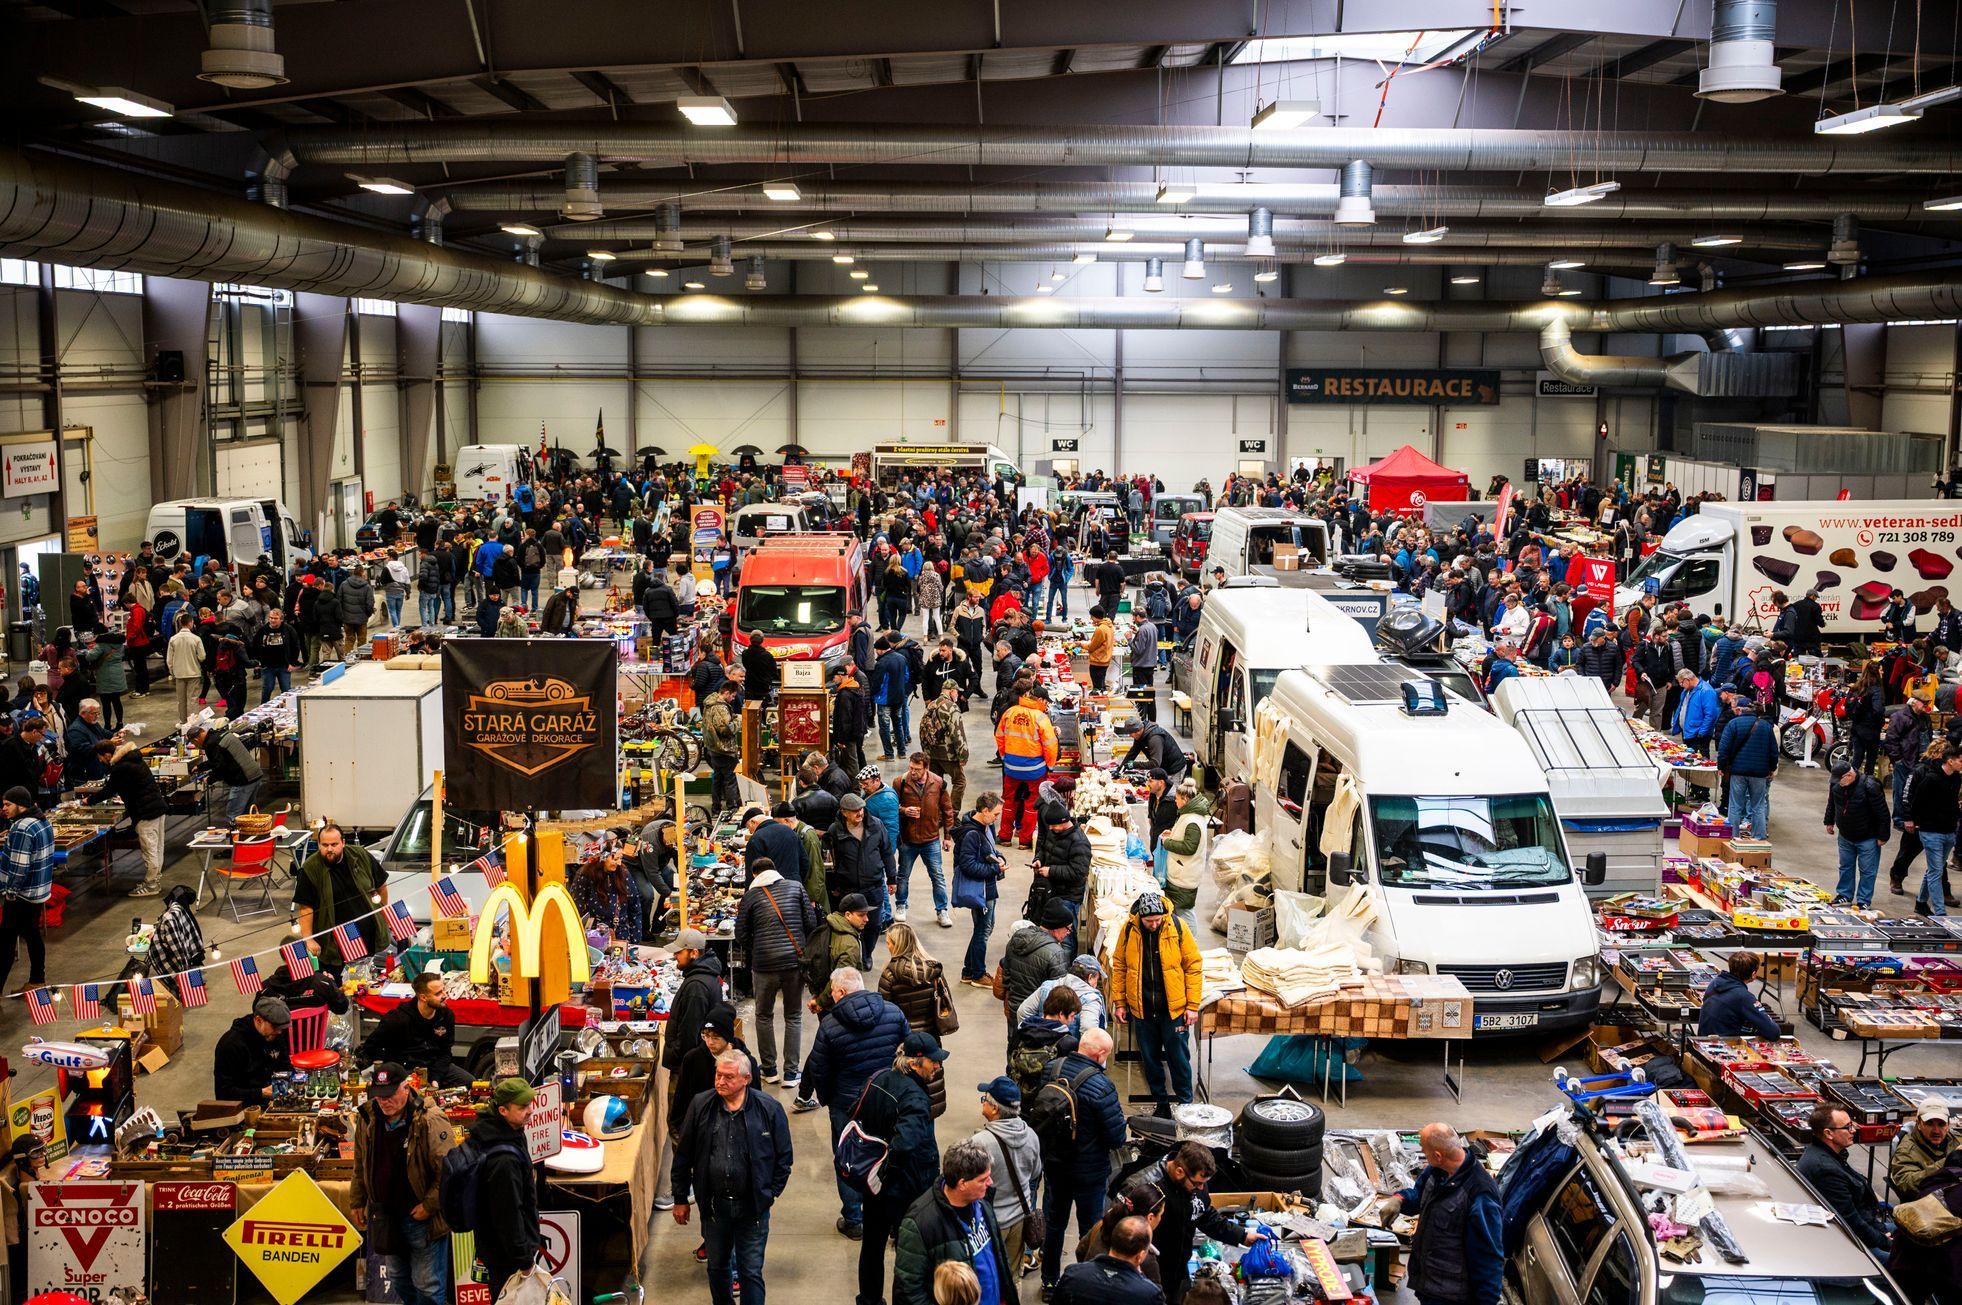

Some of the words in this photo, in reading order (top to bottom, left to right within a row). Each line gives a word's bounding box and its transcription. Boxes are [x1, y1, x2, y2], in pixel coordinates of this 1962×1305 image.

[1324, 378, 1473, 397] RESTAURACE
[1543, 381, 1592, 393] Restaurace
[1057, 440, 1074, 448] WC
[1244, 440, 1261, 448] WC
[14, 452, 46, 462] POKRAČOVÁNÍ
[20, 464, 41, 473] VÝSTAVY
[15, 477, 27, 485] HALY
[1878, 532, 1899, 543] 721
[1902, 532, 1927, 543] 308
[1931, 531, 1955, 543] 789
[1336, 605, 1378, 613] KRNOV.CZ
[464, 712, 527, 732] STARÁ
[530, 712, 596, 732] GARÁŽ
[476, 733, 526, 743] GARÁŽOVÉ
[532, 734, 583, 743] DEKORACE
[1483, 1016, 1501, 1026] 5B2
[1509, 1015, 1533, 1026] 3107
[546, 1015, 559, 1045] WAY
[41, 1051, 81, 1067] Gulf
[532, 1093, 548, 1110] NO
[33, 1112, 53, 1124] VEEDOL
[527, 1107, 559, 1130] ARKING
[532, 1127, 550, 1142] FIRE
[531, 1141, 551, 1156] LANE
[177, 1185, 232, 1202] Coca-Cola
[175, 1202, 208, 1210] praktischen
[40, 1209, 134, 1225] CONOCO
[242, 1220, 347, 1248] PIRELLI
[262, 1250, 320, 1263] BANDEN
[64, 1269, 107, 1286] Super
[460, 1289, 491, 1303] SEVE
